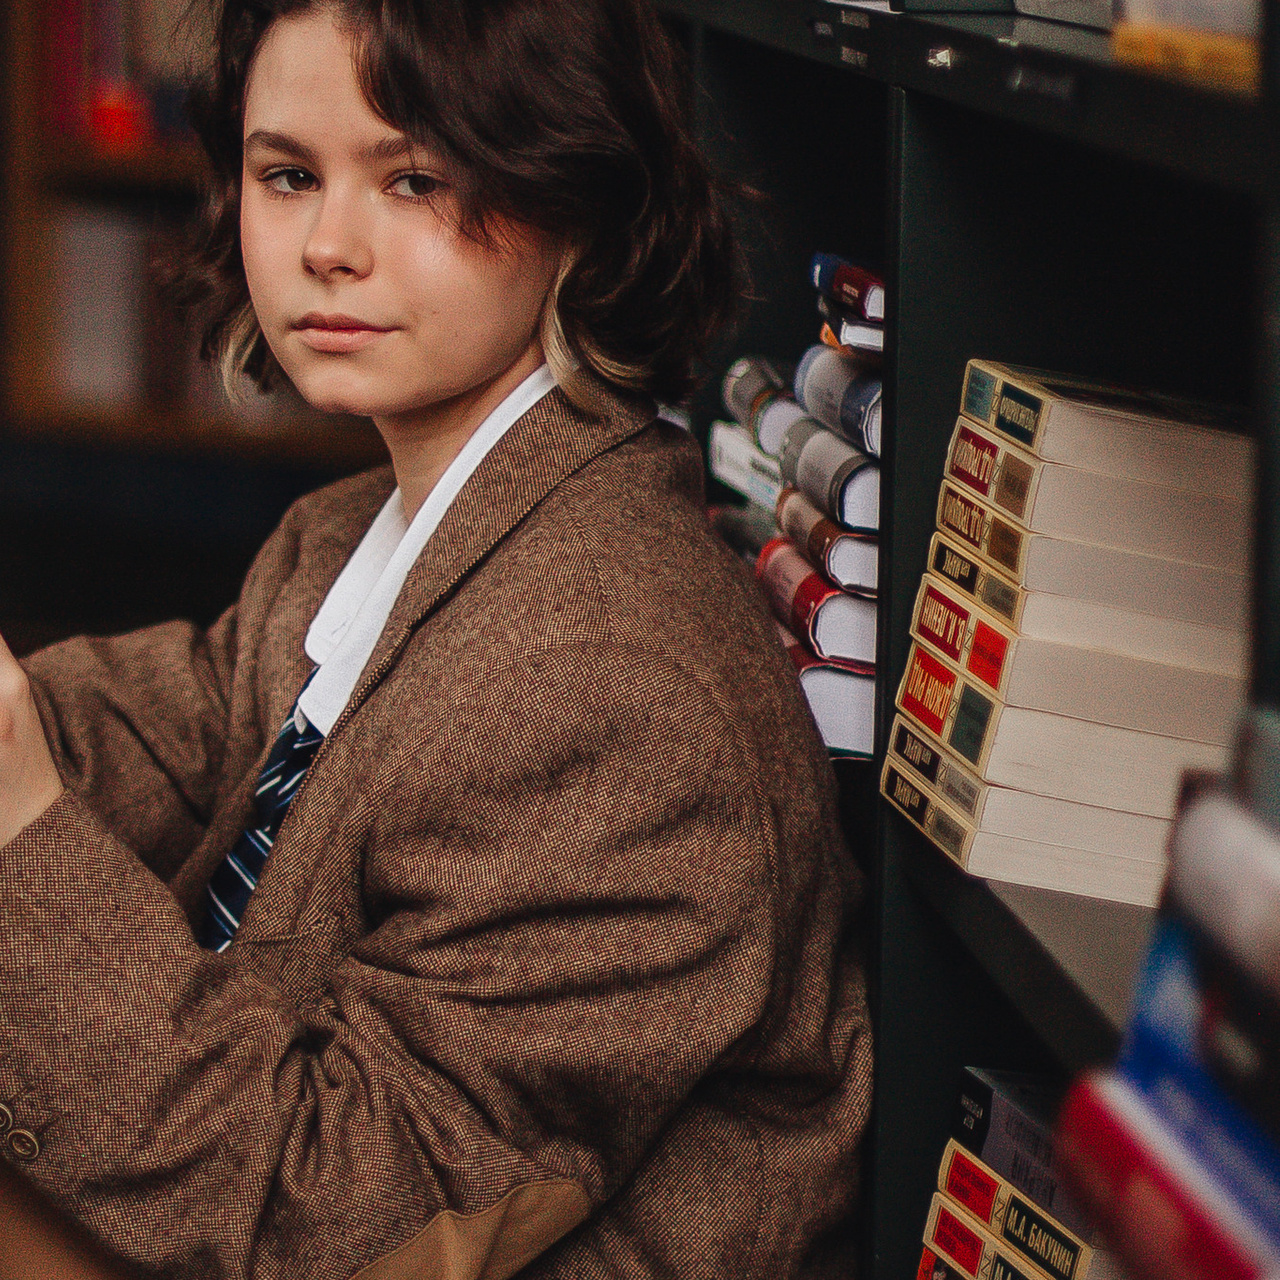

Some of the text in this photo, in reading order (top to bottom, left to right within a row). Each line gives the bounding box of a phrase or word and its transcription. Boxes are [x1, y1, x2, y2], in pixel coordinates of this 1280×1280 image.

[920, 593, 949, 639] ЛЕНИН
[907, 654, 928, 704] РИД
[923, 674, 951, 722] ДЖОН
[1027, 1222, 1073, 1277] БАКУНИН
